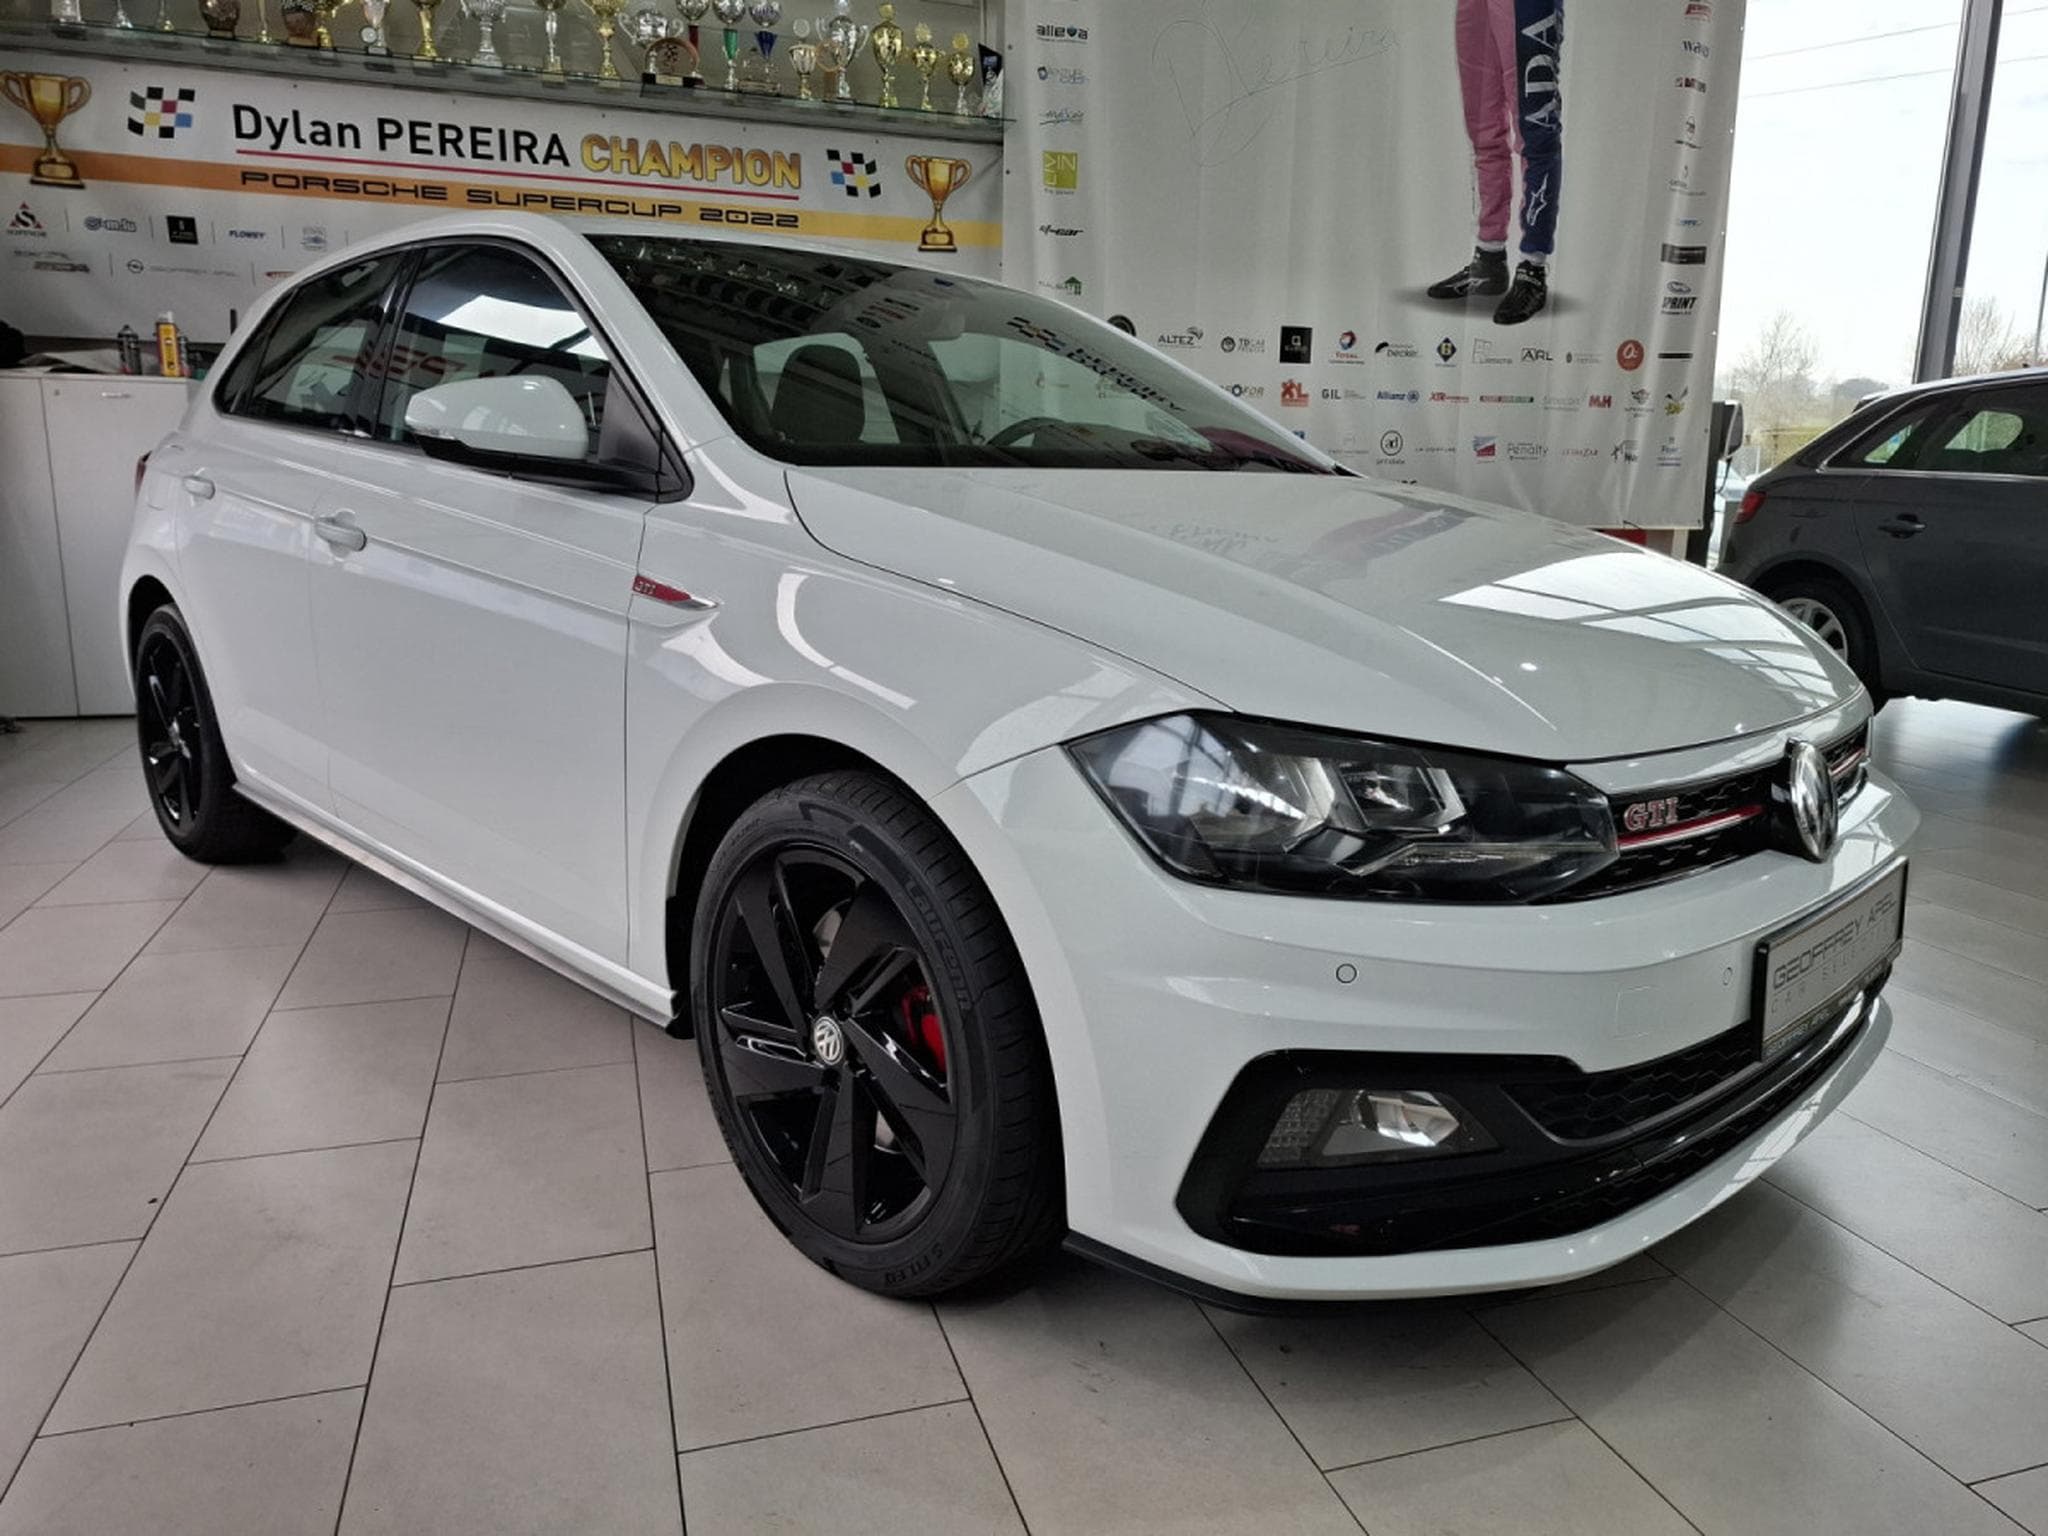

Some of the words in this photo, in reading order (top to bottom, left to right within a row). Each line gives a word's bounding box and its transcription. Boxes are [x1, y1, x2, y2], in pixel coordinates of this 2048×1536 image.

[232, 103, 361, 150] Dylan
[376, 117, 571, 167] PEREIRA
[580, 133, 801, 189] CHAMPION
[240, 170, 448, 200] PORSCHE
[466, 188, 682, 218] SUPERCUP
[700, 207, 800, 229] 2022
[1157, 334, 1195, 346] ALTEZ
[1321, 388, 1342, 401] GIL
[1624, 796, 1680, 831] GTI
